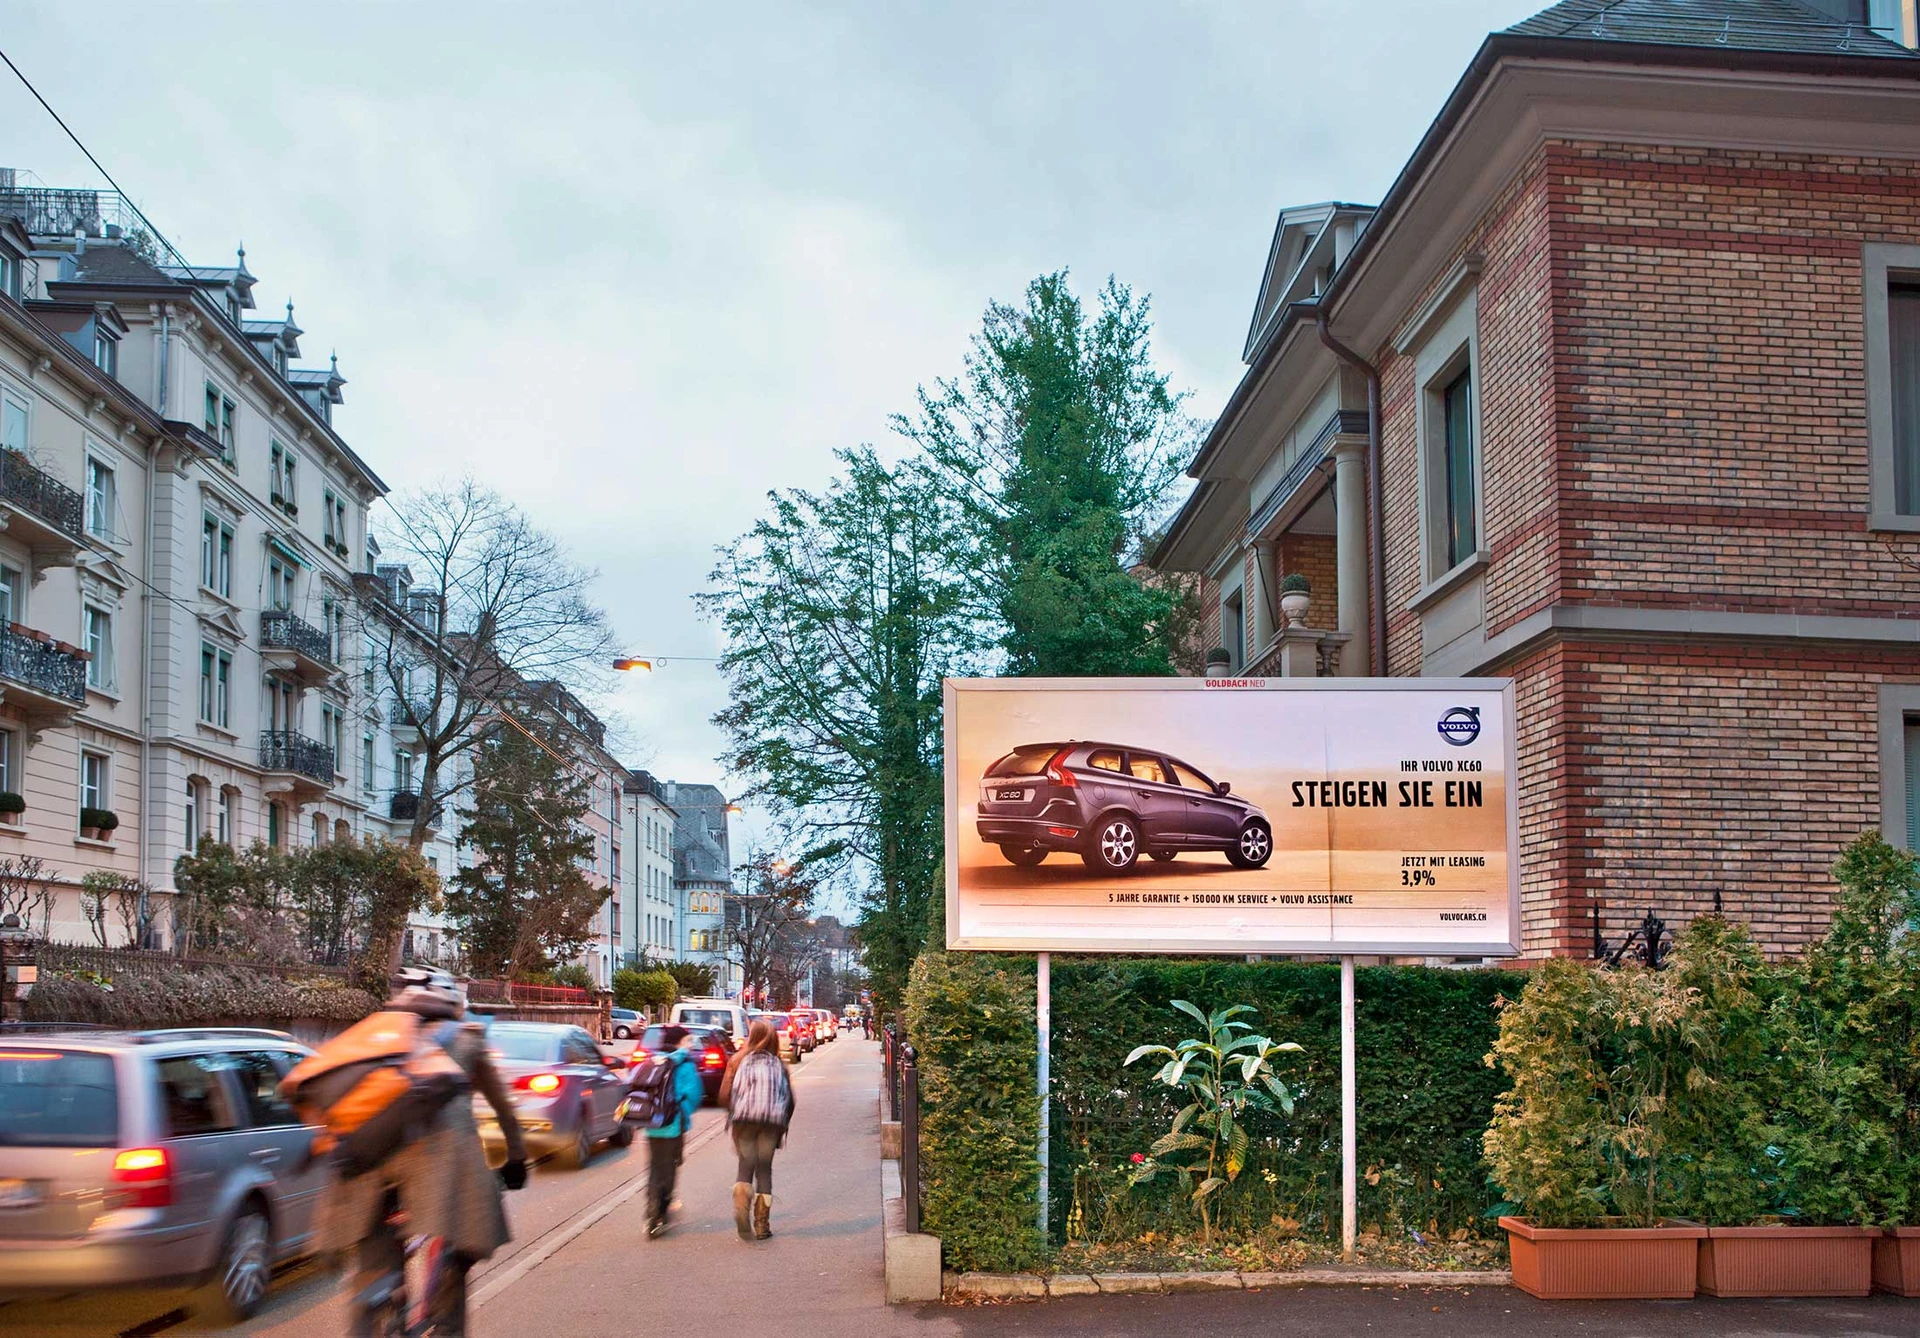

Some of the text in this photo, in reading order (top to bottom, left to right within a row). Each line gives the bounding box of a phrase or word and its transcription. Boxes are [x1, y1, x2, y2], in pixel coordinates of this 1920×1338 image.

[1205, 679, 1266, 688] GOLDBACH NEO
[1400, 760, 1482, 772] IHR VOLVO XC60
[1291, 780, 1483, 808] STEIGEN SIE EIN
[1401, 856, 1486, 867] JETZT MIT LEASING
[1401, 870, 1436, 887] 3,9%
[1108, 893, 1114, 903] 5
[1116, 893, 1140, 903] JAHRE
[1142, 894, 1181, 904] GARANTIE
[1222, 894, 1235, 904] KM
[1237, 894, 1269, 904] SERVICE
[1280, 895, 1305, 905] VOLVO
[1307, 895, 1354, 905] ASSISTANCE
[1439, 912, 1487, 922] VOLVOCARS.CH
